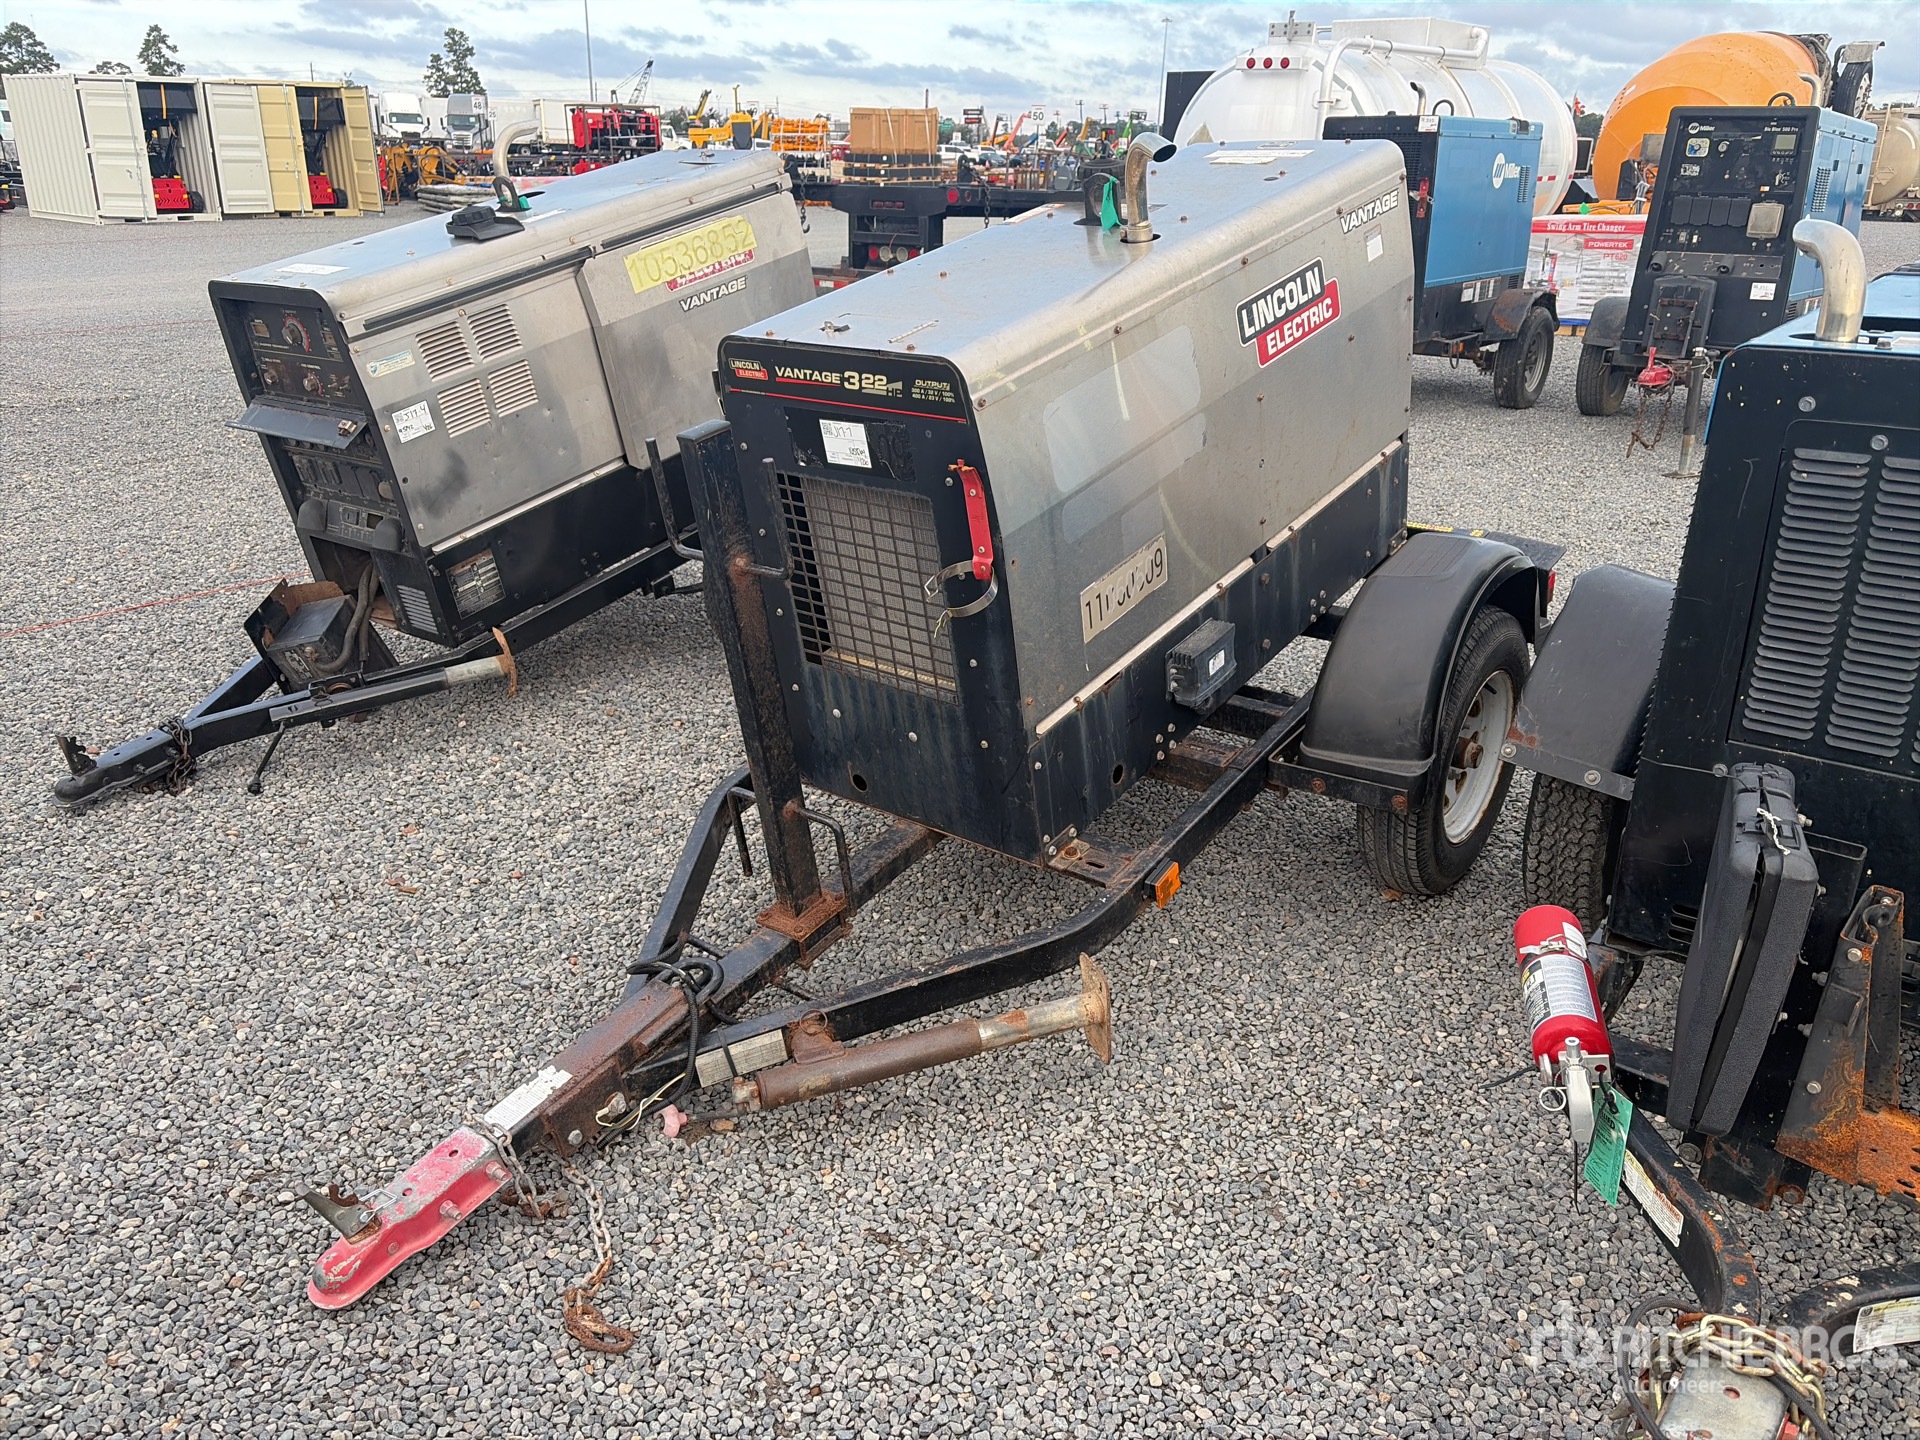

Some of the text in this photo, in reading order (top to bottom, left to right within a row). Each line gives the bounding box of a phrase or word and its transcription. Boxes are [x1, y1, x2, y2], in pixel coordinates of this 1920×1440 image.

[473, 101, 483, 110] 48
[1032, 111, 1045, 121] 50
[1339, 189, 1400, 235] VANTAGE
[1547, 222, 1626, 232] Swing Arm Tire Changer
[628, 219, 755, 289] 10536852
[1603, 252, 1628, 260] PT620
[679, 277, 748, 312] VANTAGE
[1241, 266, 1323, 338] LINCOLN
[1266, 297, 1333, 356] ELECTRIC
[730, 360, 760, 371] LINCOLN
[739, 370, 765, 378] ELECTRIC
[774, 365, 841, 384] VANTAGE
